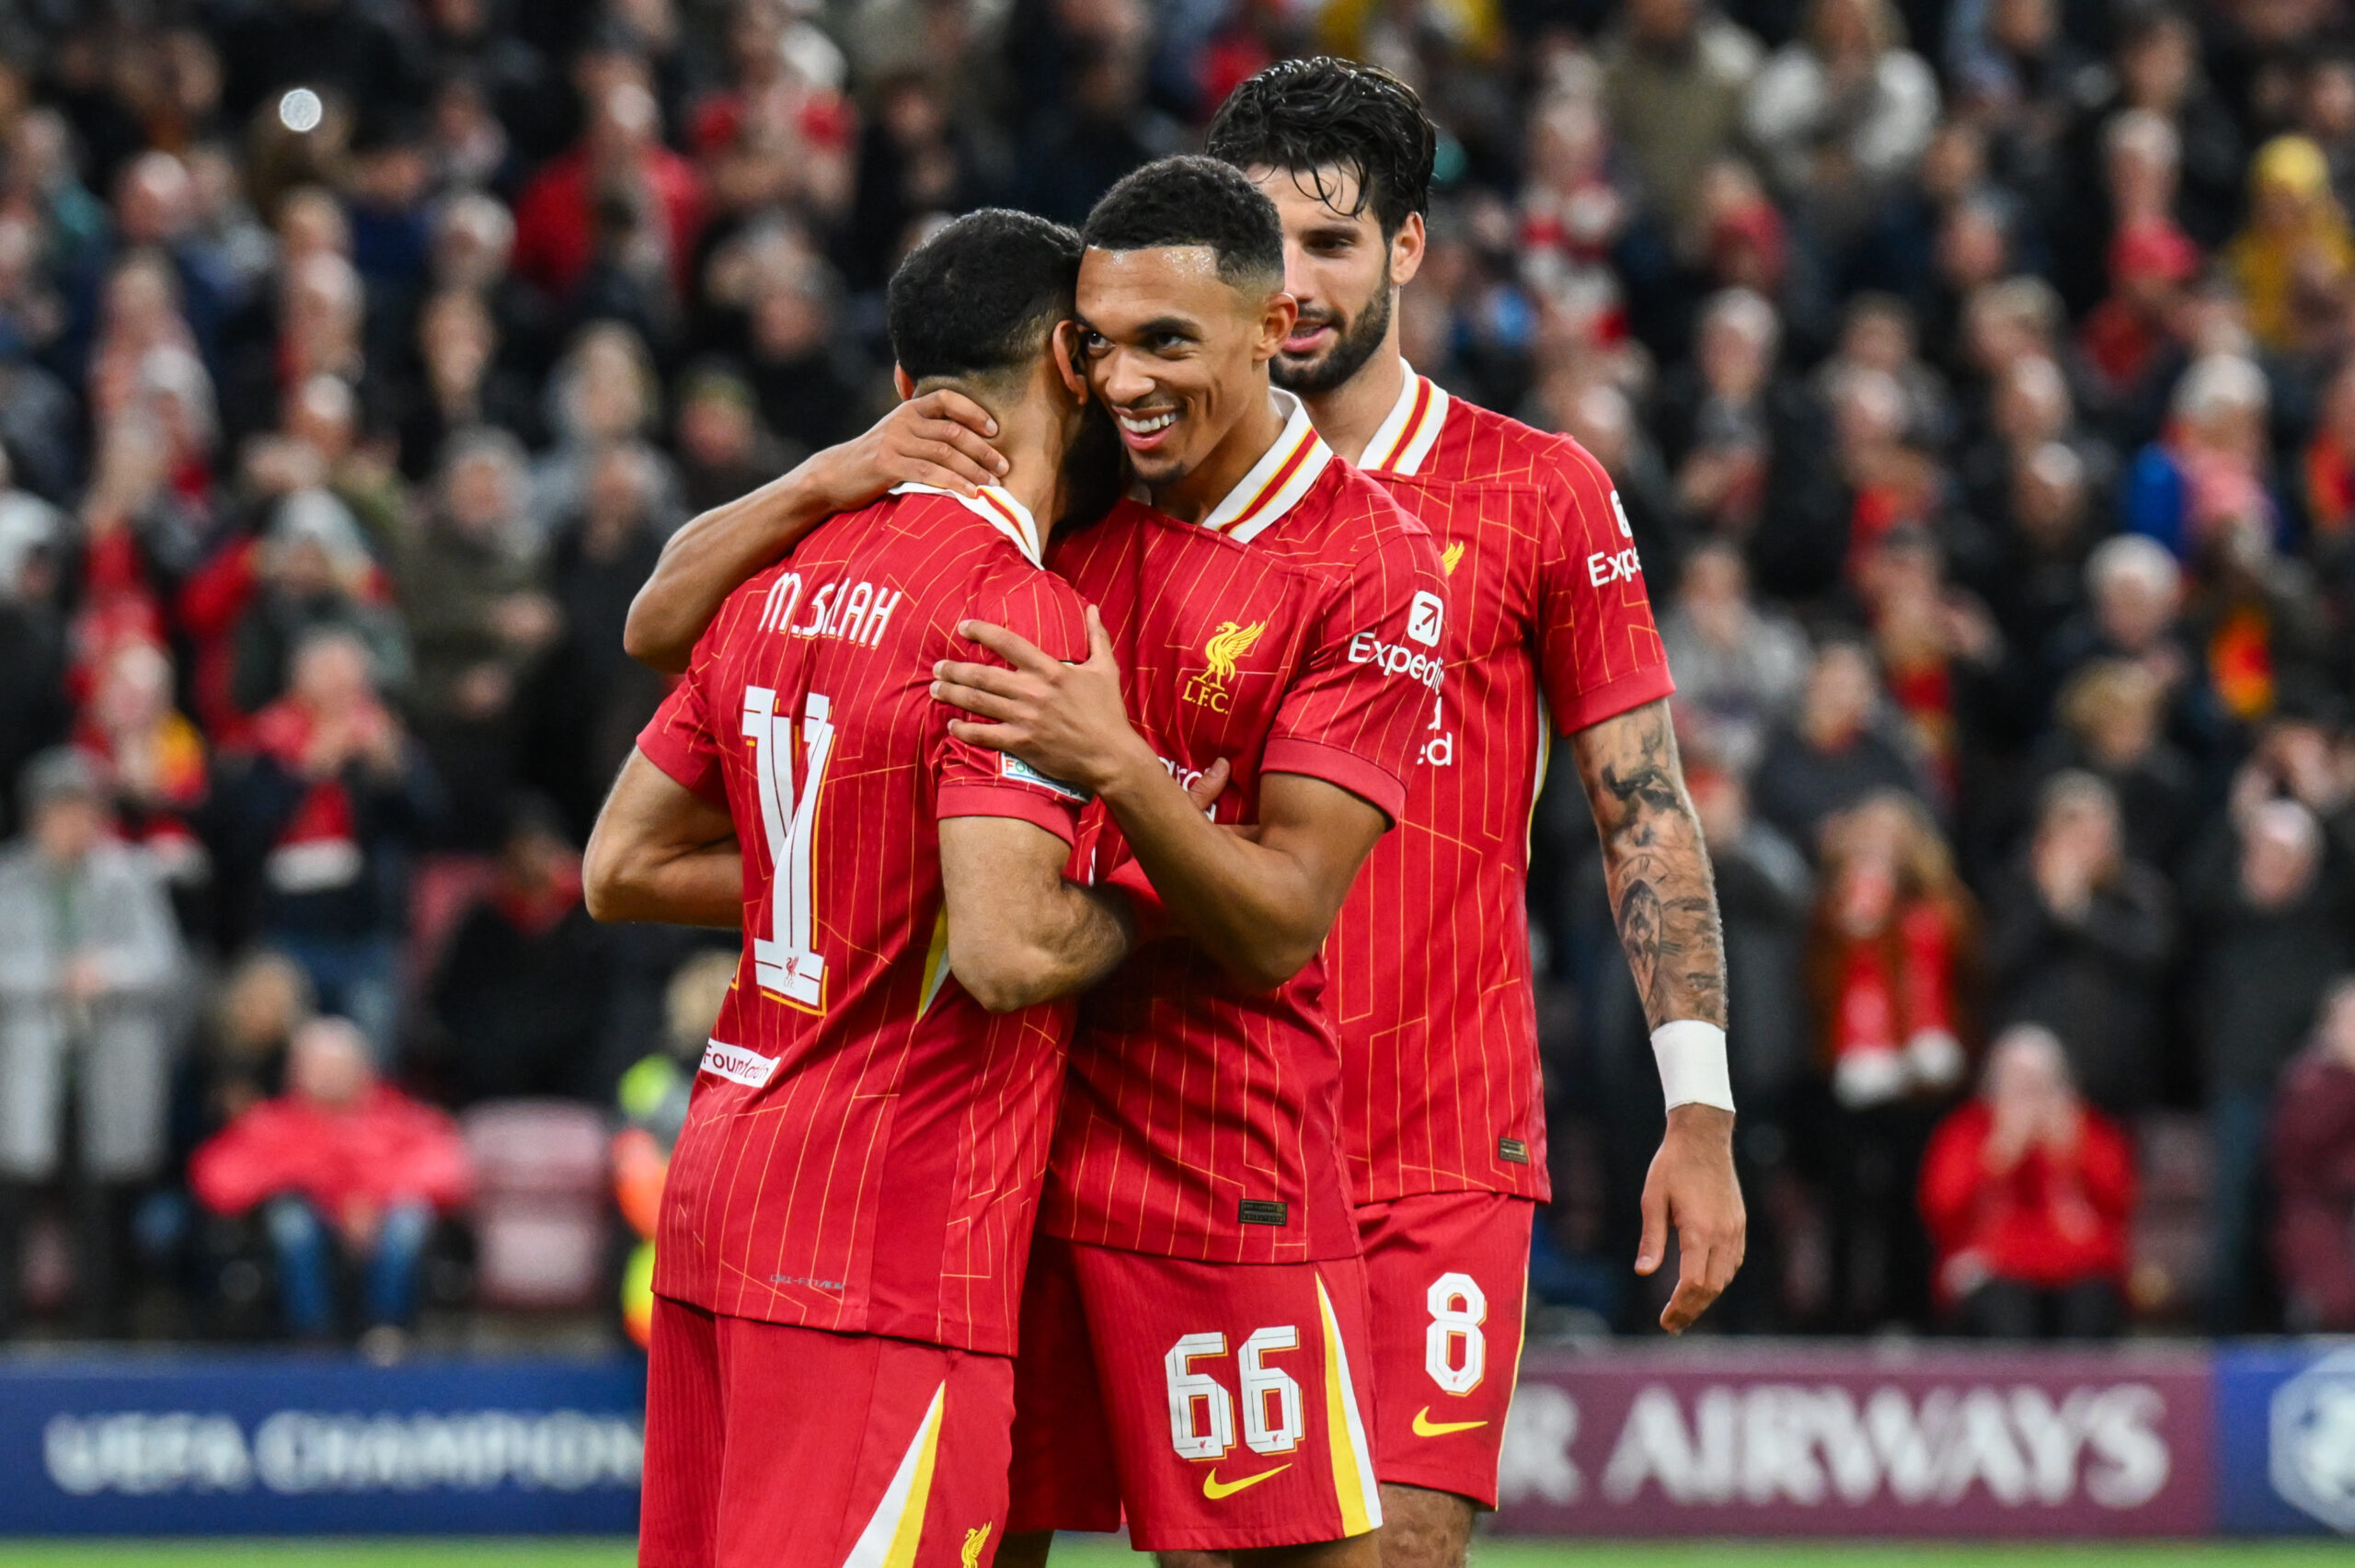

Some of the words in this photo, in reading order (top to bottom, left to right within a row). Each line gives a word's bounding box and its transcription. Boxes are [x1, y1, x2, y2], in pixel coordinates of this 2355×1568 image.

[1165, 1324, 1305, 1461] 66
[1425, 1272, 1488, 1397] 8
[44, 1409, 253, 1494] UEFA
[1602, 1381, 2171, 1508] AIRWAYS
